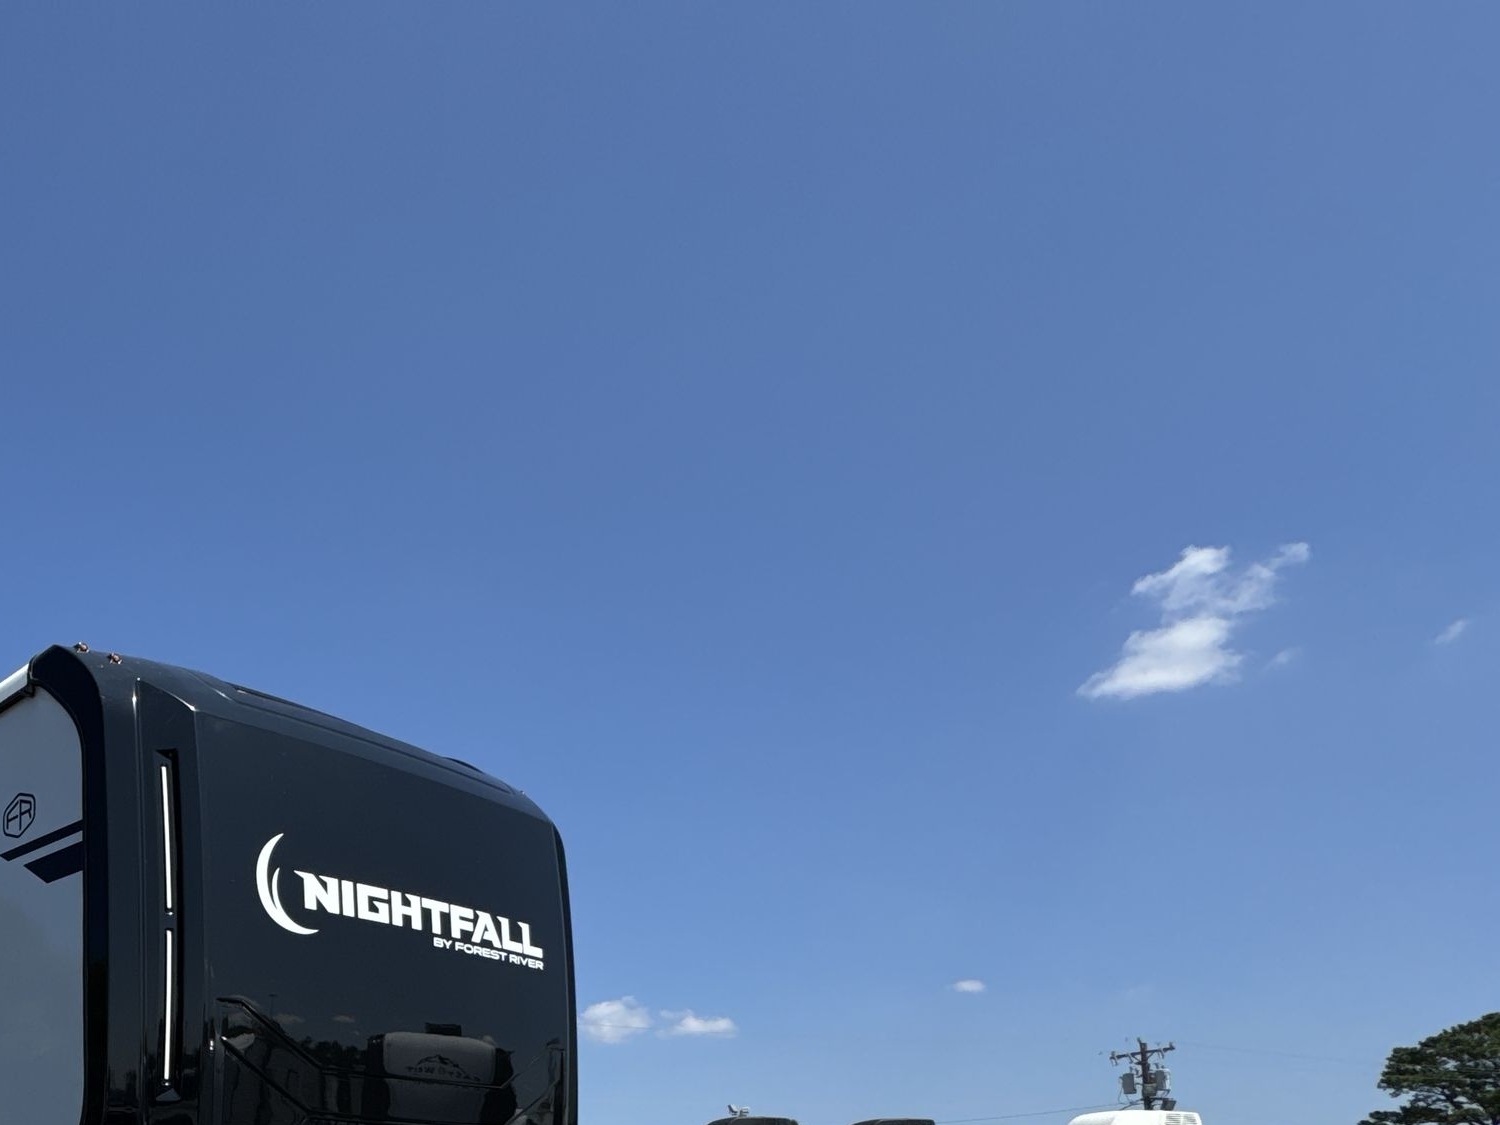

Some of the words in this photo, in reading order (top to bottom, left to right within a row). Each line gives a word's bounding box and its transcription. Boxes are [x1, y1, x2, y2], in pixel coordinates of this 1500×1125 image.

[294, 870, 543, 958] NIGHTFALL
[433, 937, 452, 948] BY
[455, 941, 506, 962] FOREST
[509, 954, 544, 970] RIVER
